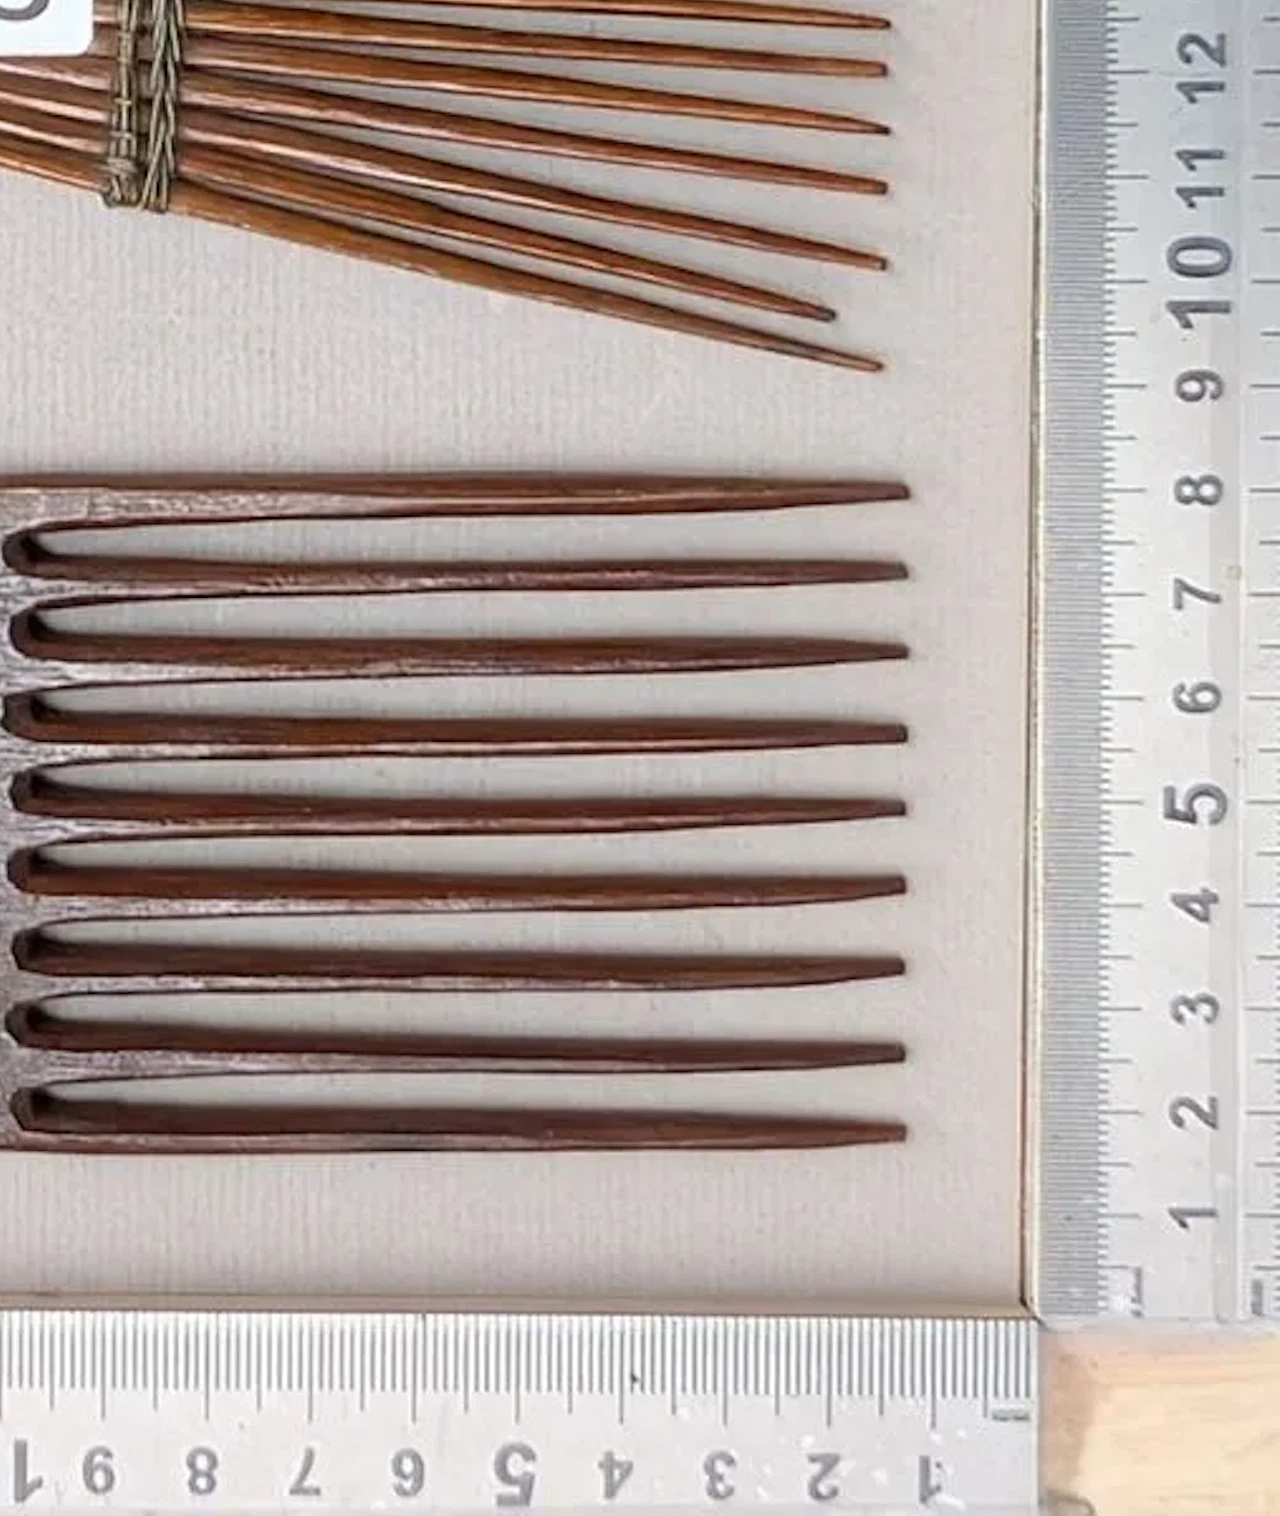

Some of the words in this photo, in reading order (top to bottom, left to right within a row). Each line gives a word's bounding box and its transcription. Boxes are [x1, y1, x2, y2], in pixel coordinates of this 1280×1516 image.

[1175, 32, 1228, 104] 12
[1175, 148, 1226, 210] 11
[1166, 236, 1234, 330] 10
[1174, 368, 1225, 403] 9
[1173, 474, 1224, 507] 8
[1172, 578, 1223, 611] 7
[1172, 681, 1223, 714] 6
[1163, 783, 1229, 827] 5
[1170, 887, 1220, 924] 4
[1170, 992, 1221, 1027] 3
[1168, 1095, 1220, 1131] 2
[1167, 1206, 1219, 1232] 1
[81, 1445, 116, 1495] 9
[184, 1446, 220, 1496] 8
[288, 1447, 322, 1497] 7
[390, 1448, 425, 1498] 6
[493, 1441, 539, 1507] 5
[597, 1450, 634, 1500] 4
[703, 1450, 737, 1501] 3
[806, 1452, 841, 1502] 2
[917, 1453, 942, 1504] 1
